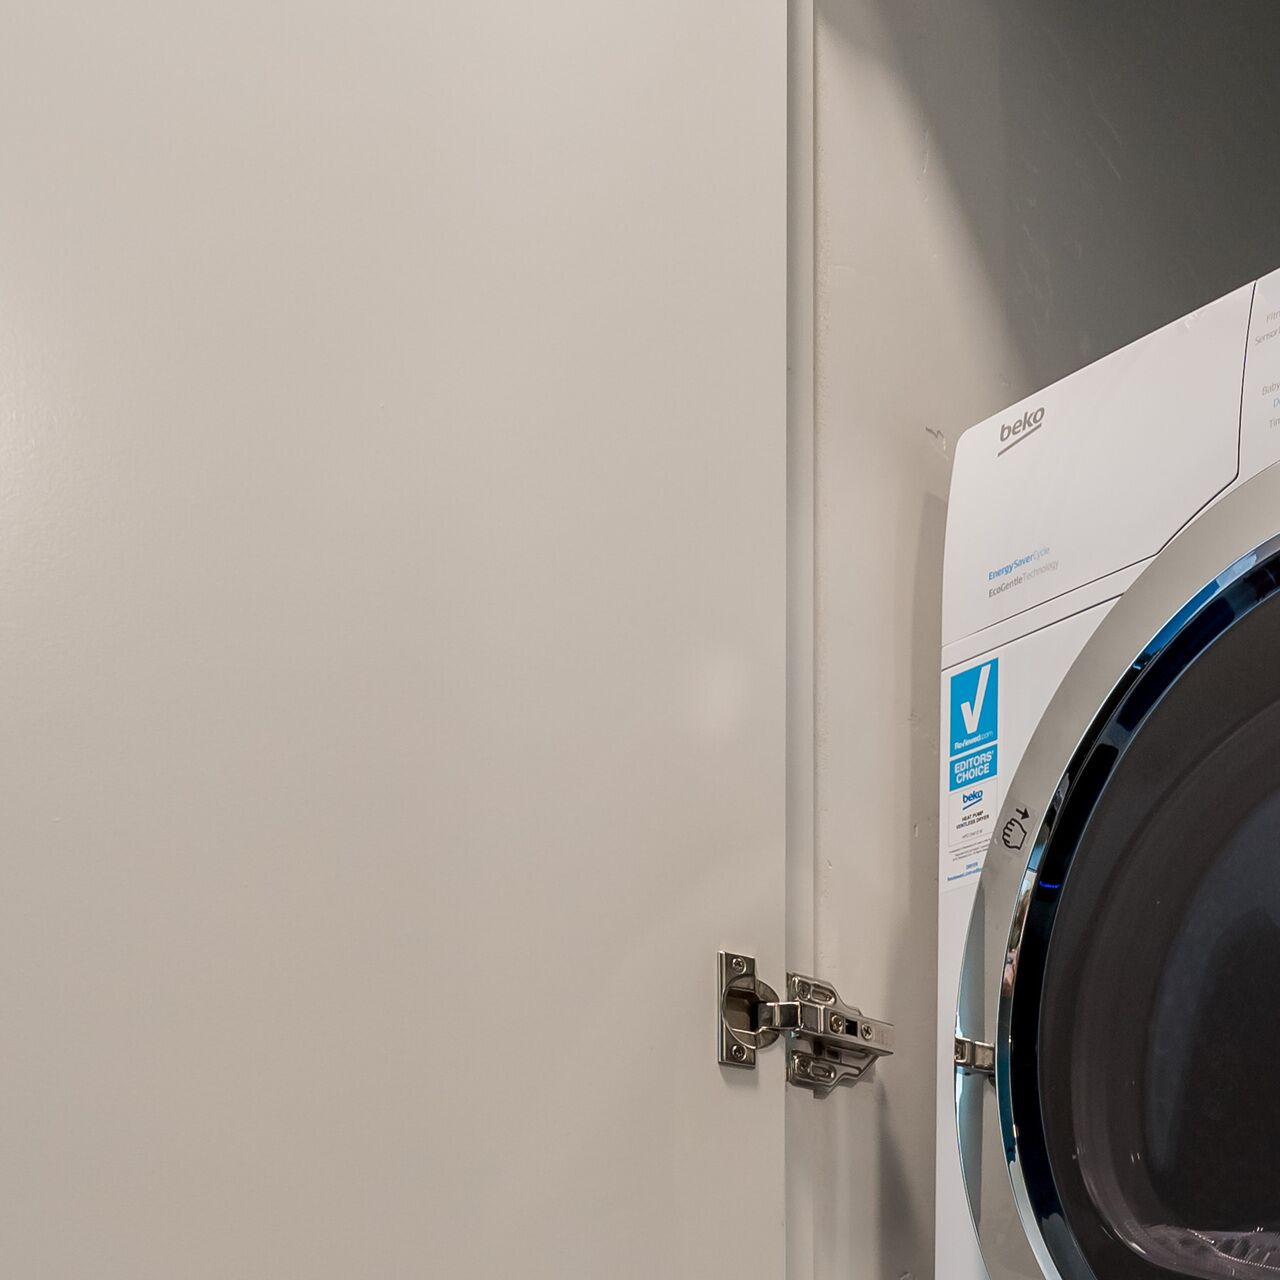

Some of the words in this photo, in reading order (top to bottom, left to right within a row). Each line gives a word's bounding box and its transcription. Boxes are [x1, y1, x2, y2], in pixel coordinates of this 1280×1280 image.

[1000, 407, 1045, 442] beko
[954, 750, 994, 774] EDITORS'
[956, 763, 990, 784] CHOICE
[962, 790, 983, 803] beko
